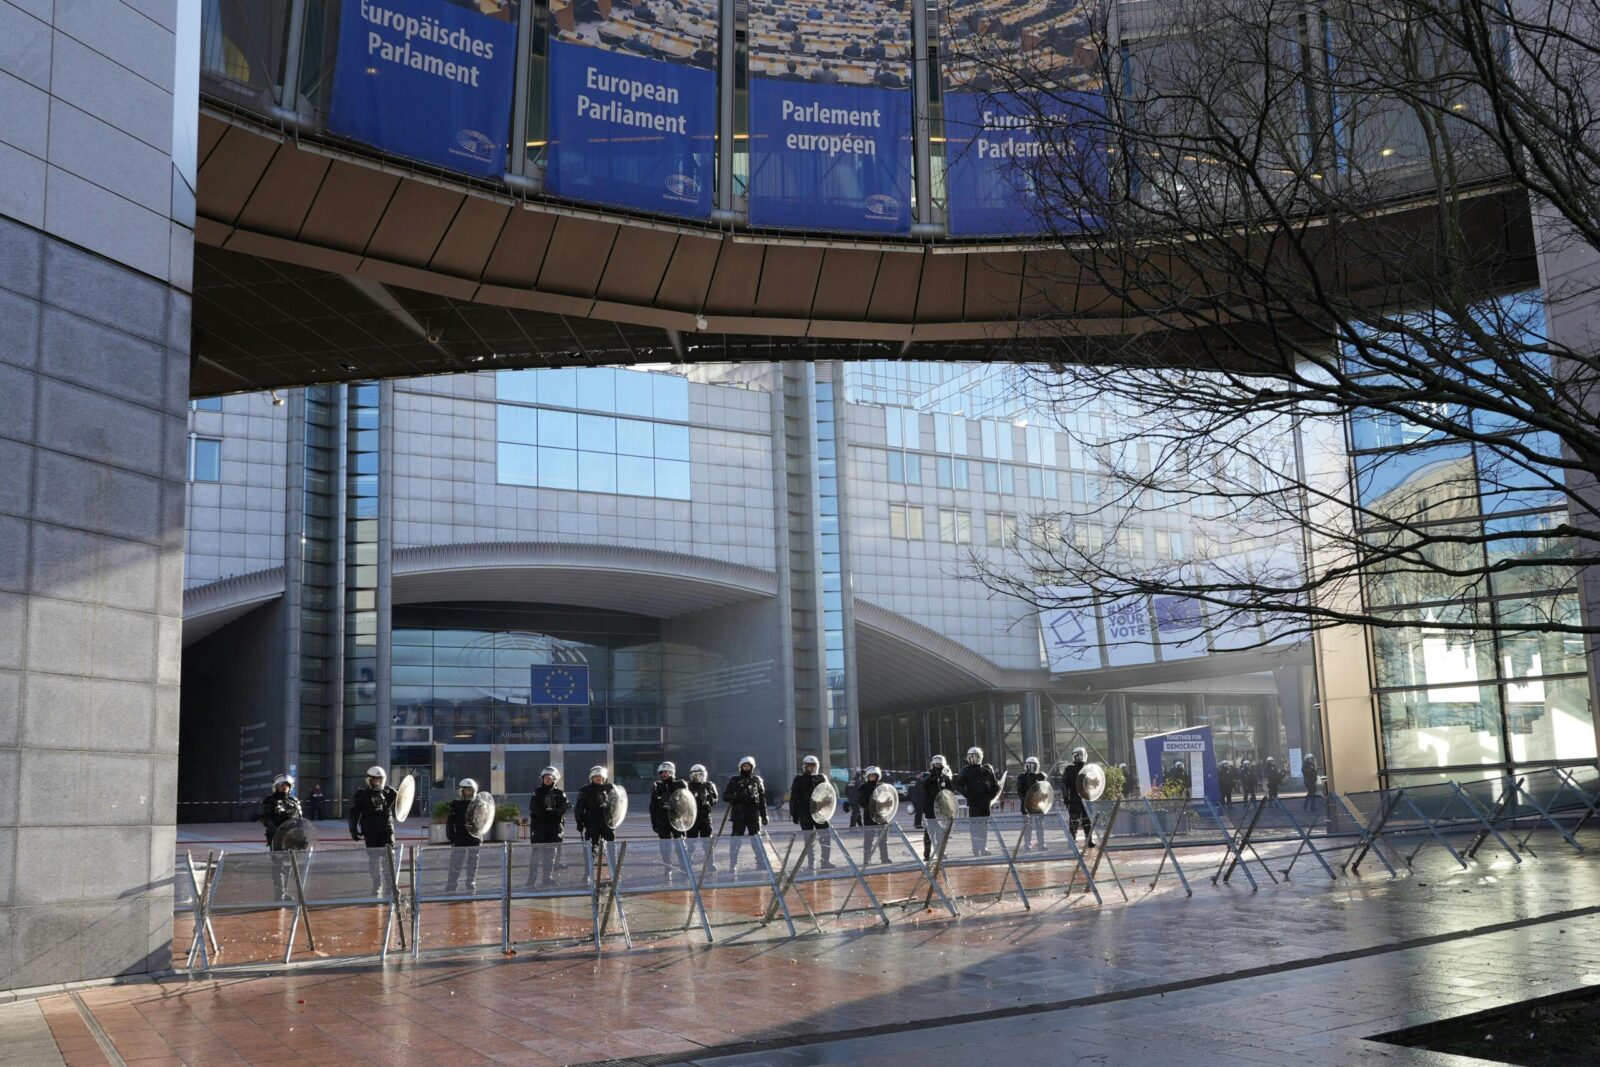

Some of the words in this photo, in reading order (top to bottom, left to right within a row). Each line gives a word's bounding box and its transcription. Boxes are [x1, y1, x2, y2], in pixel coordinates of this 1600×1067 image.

[361, 0, 494, 60] Europäisches
[368, 31, 480, 88] Parlament
[586, 66, 679, 105] European
[577, 94, 687, 135] Parliament
[782, 99, 881, 128] Parlement
[983, 111, 1068, 135] Europes
[786, 132, 876, 157] européen
[1109, 613, 1145, 627] YOUR
[1110, 624, 1146, 638] VOTE
